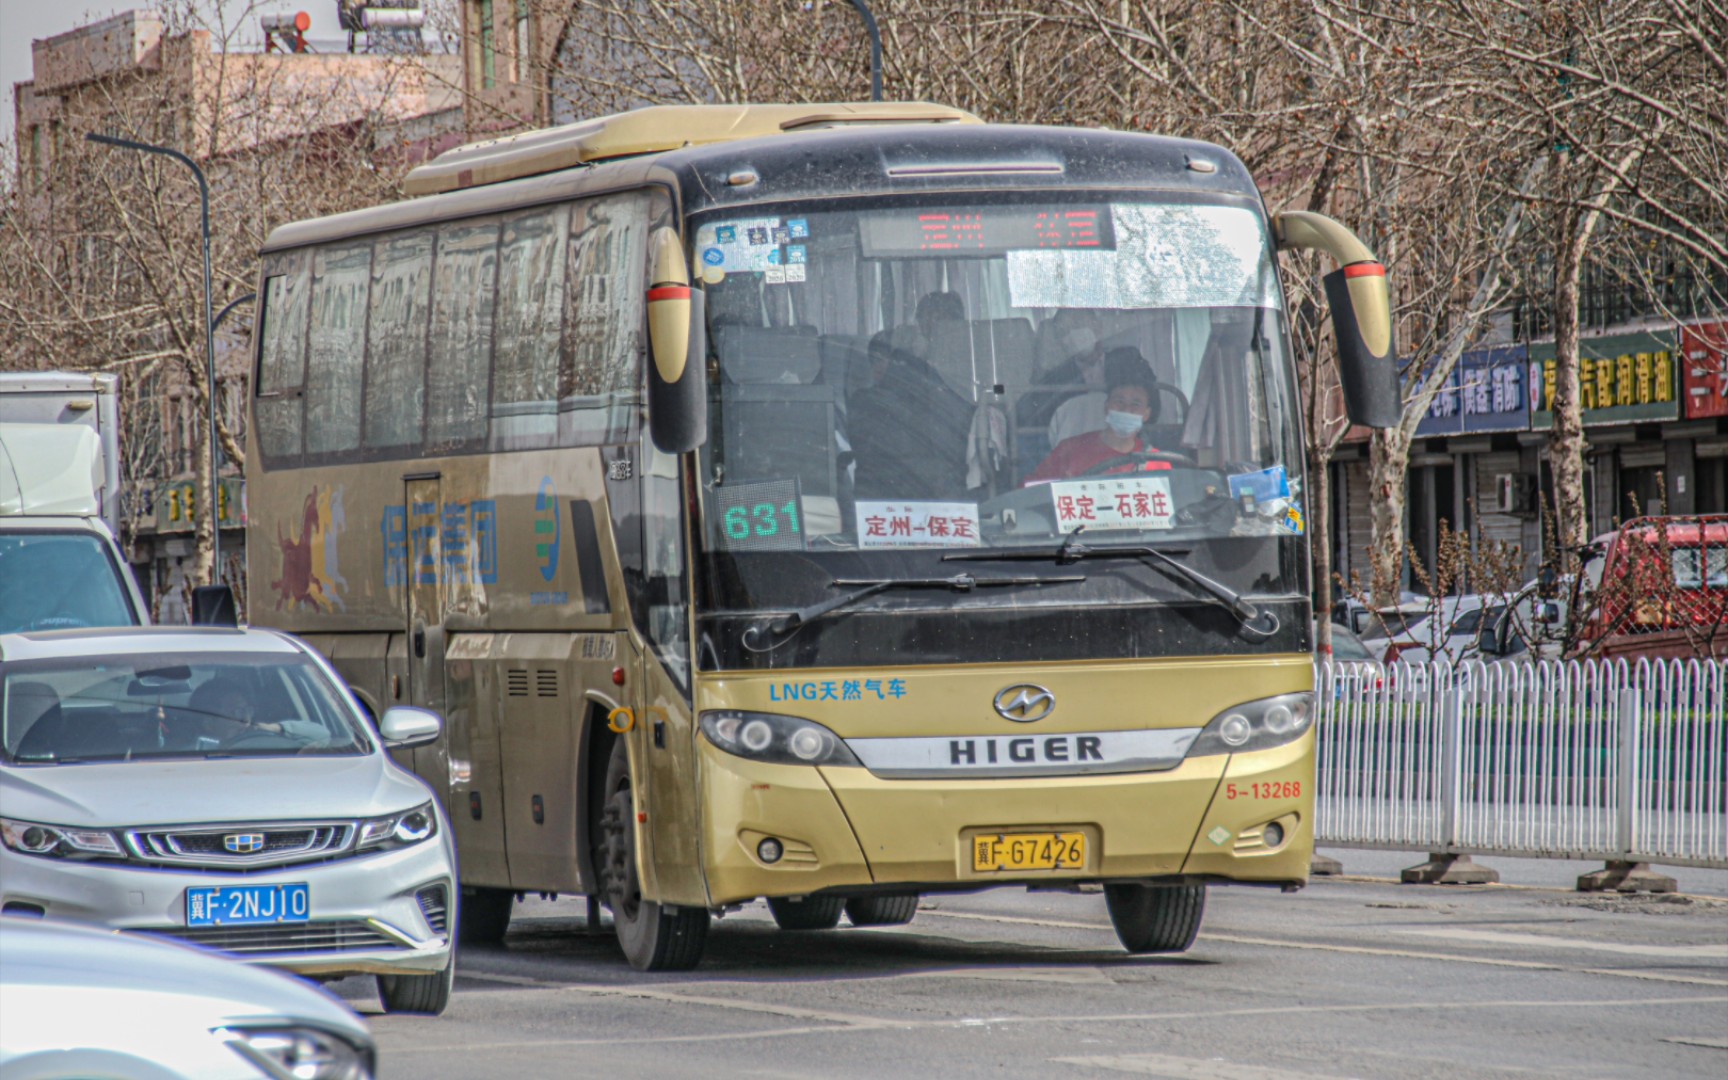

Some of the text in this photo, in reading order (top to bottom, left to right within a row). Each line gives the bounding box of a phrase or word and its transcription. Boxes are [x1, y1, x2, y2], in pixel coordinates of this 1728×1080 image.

[1543, 351, 1672, 411] 福汽配润滑油
[724, 500, 799, 539] 631
[1057, 491, 1170, 521] 保定—石家庄
[770, 678, 907, 701] LNG天然气车
[949, 736, 1104, 764] HIGER
[1226, 781, 1302, 800] 5-13268
